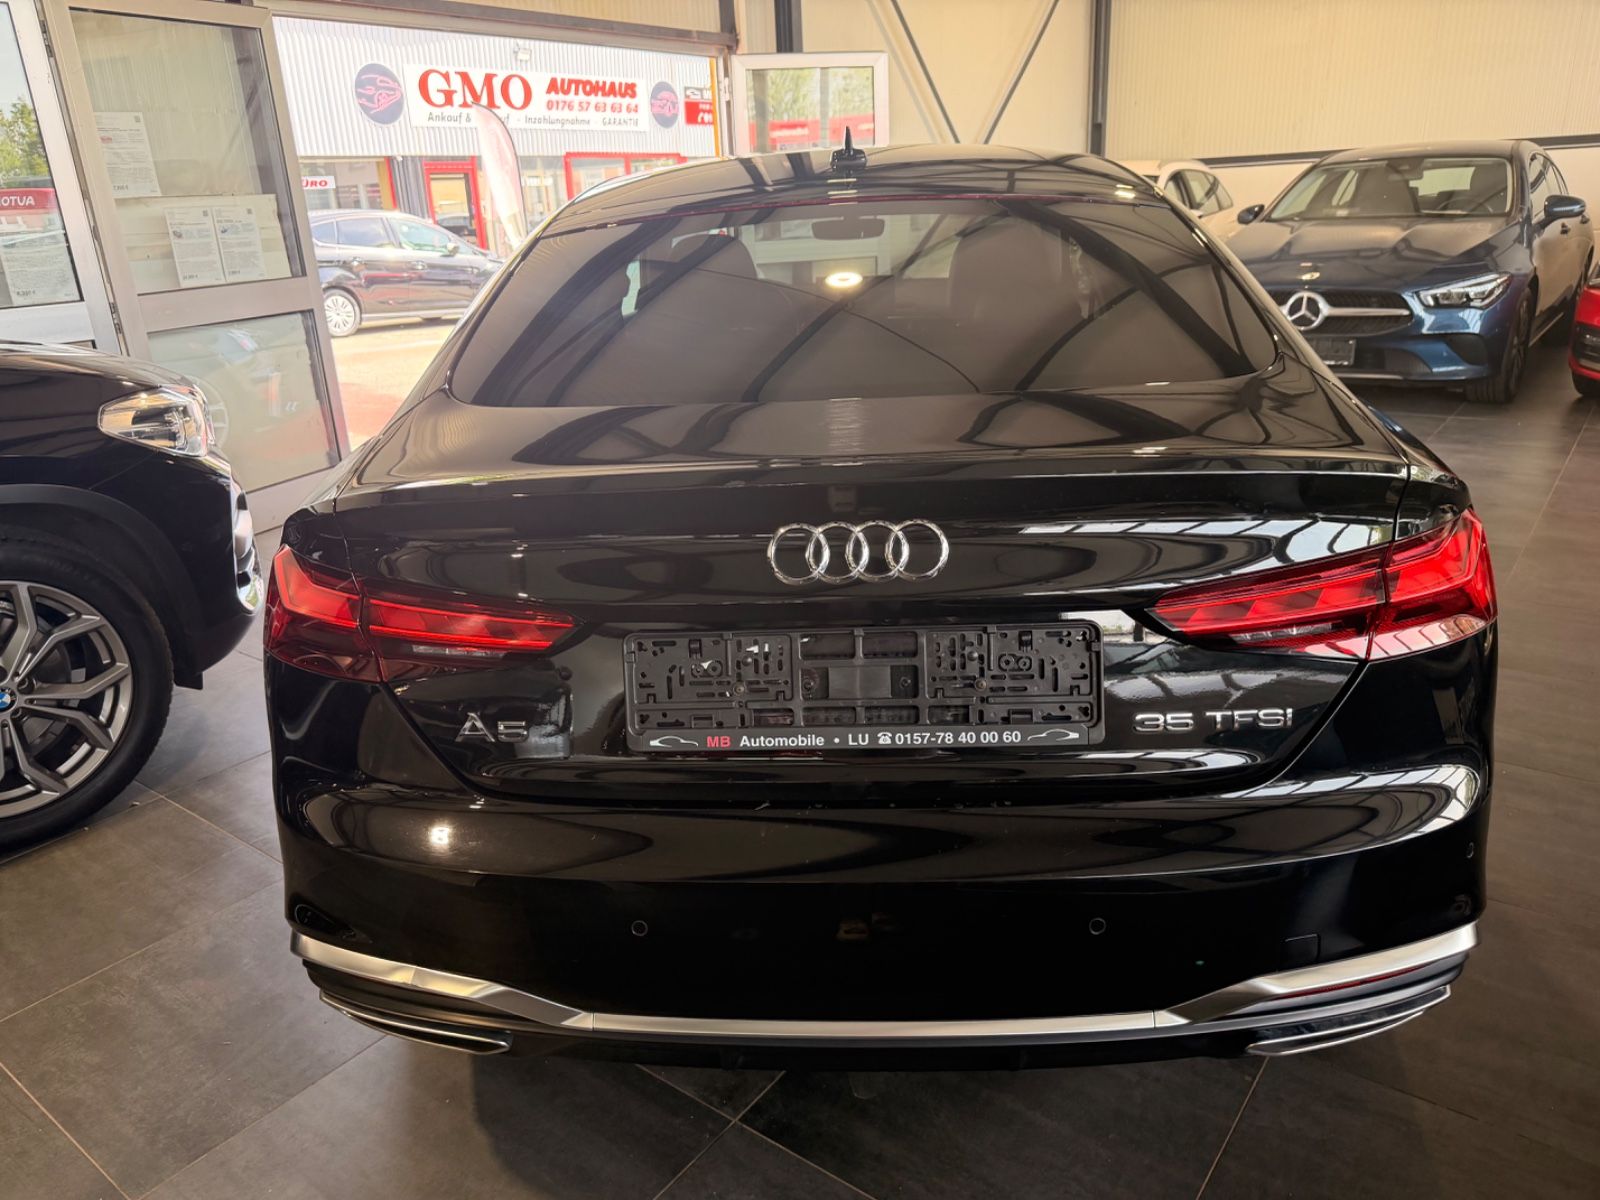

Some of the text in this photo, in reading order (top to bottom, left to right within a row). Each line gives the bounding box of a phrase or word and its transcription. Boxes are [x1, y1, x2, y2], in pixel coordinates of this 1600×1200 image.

[418, 69, 533, 111] GMO
[546, 77, 638, 99] AUTOHAUS
[546, 100, 639, 114] 0176 57 63 63 64
[427, 112, 463, 125] Ankauf
[465, 112, 472, 123] &
[602, 117, 639, 127] GARANTIE
[455, 711, 530, 743] A5
[1134, 707, 1294, 733] 35 TFSI
[706, 730, 1022, 748] MB Automobile LU 0157-78 40 00 60
